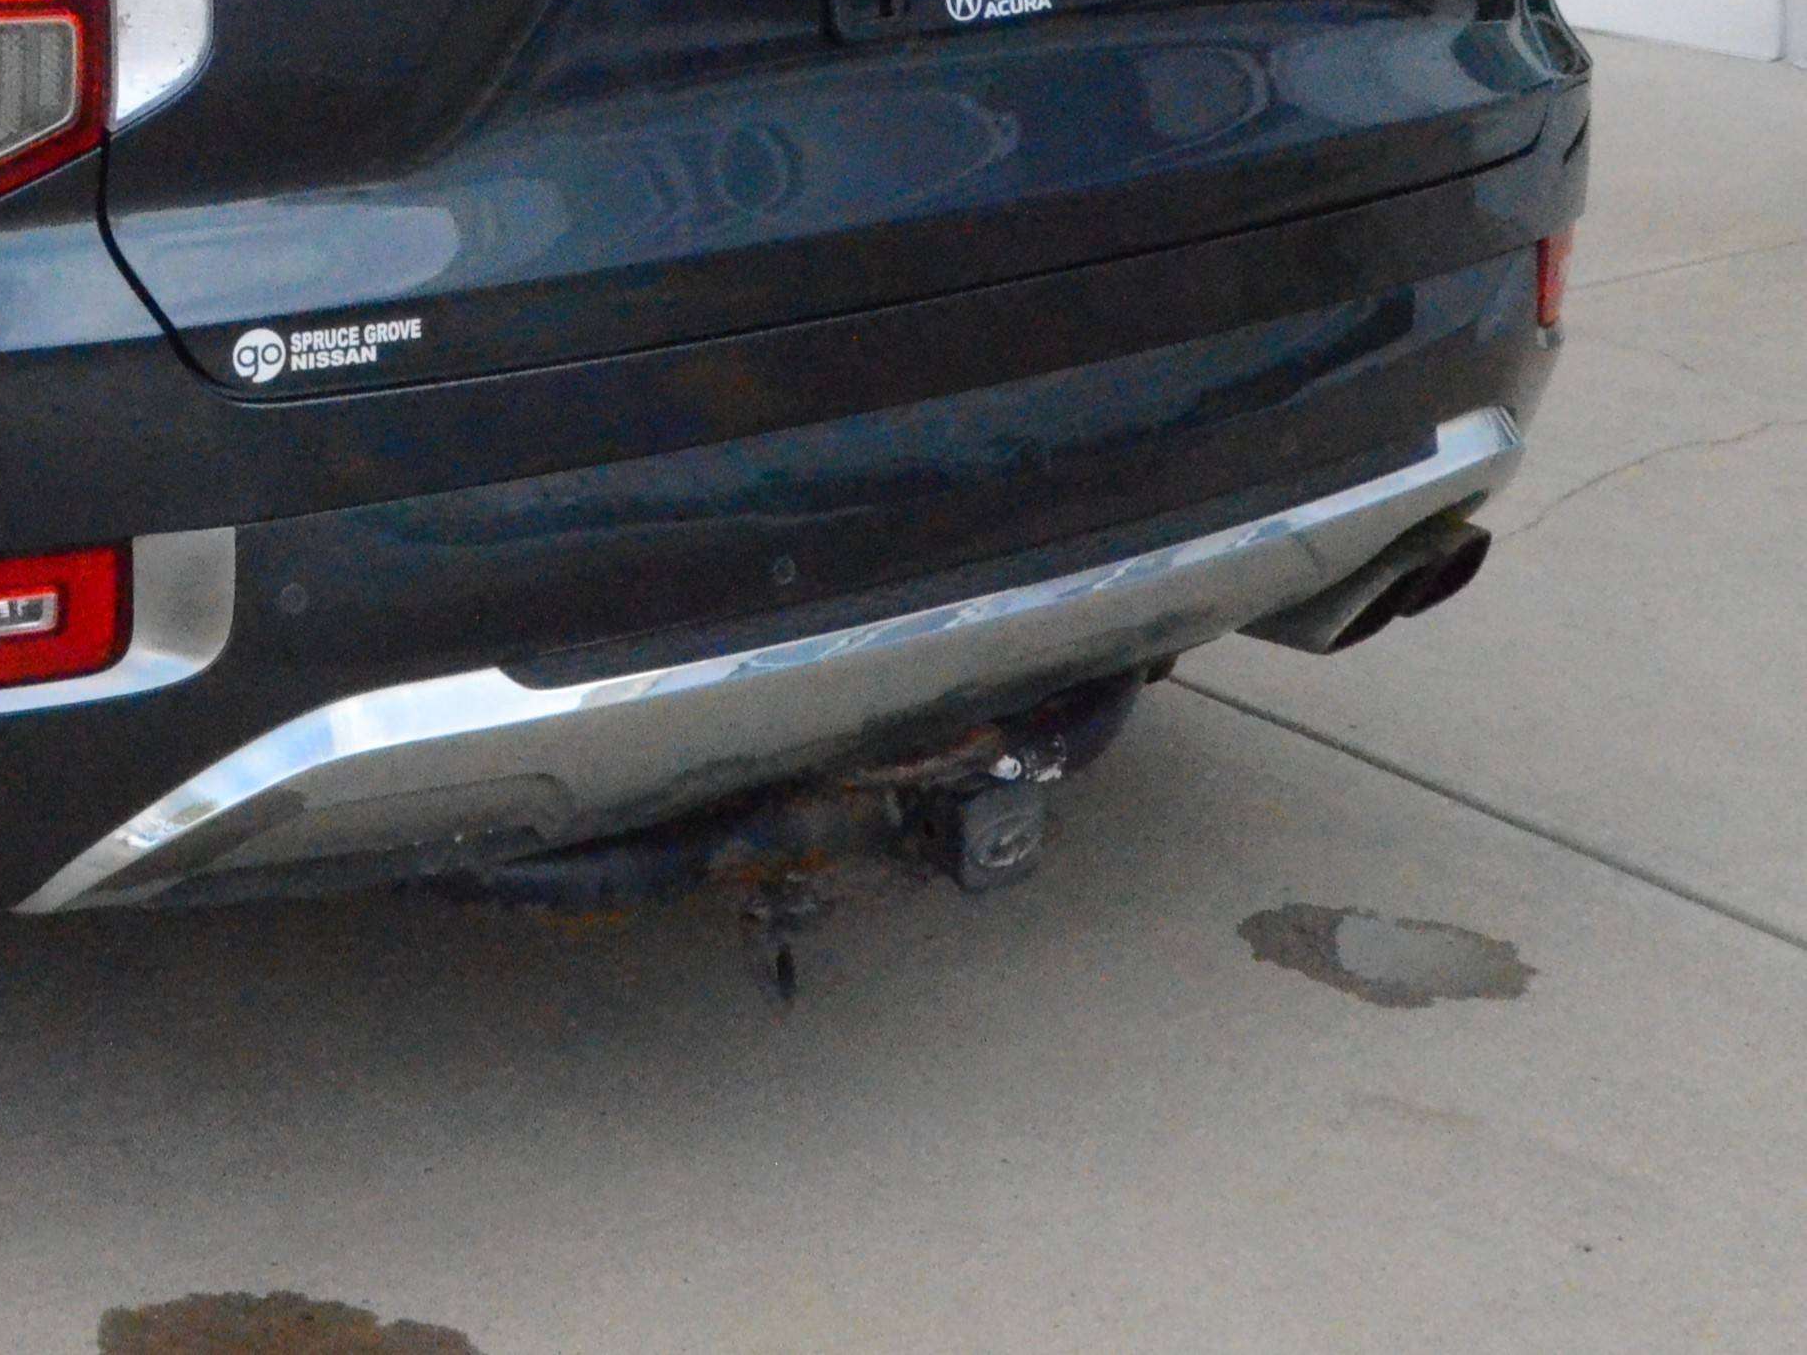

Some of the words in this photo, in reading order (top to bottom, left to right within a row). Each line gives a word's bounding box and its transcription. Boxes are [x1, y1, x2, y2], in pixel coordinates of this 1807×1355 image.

[290, 325, 360, 354] SPRUCE
[363, 318, 422, 345] GROVE
[290, 346, 377, 371] NISSAN
